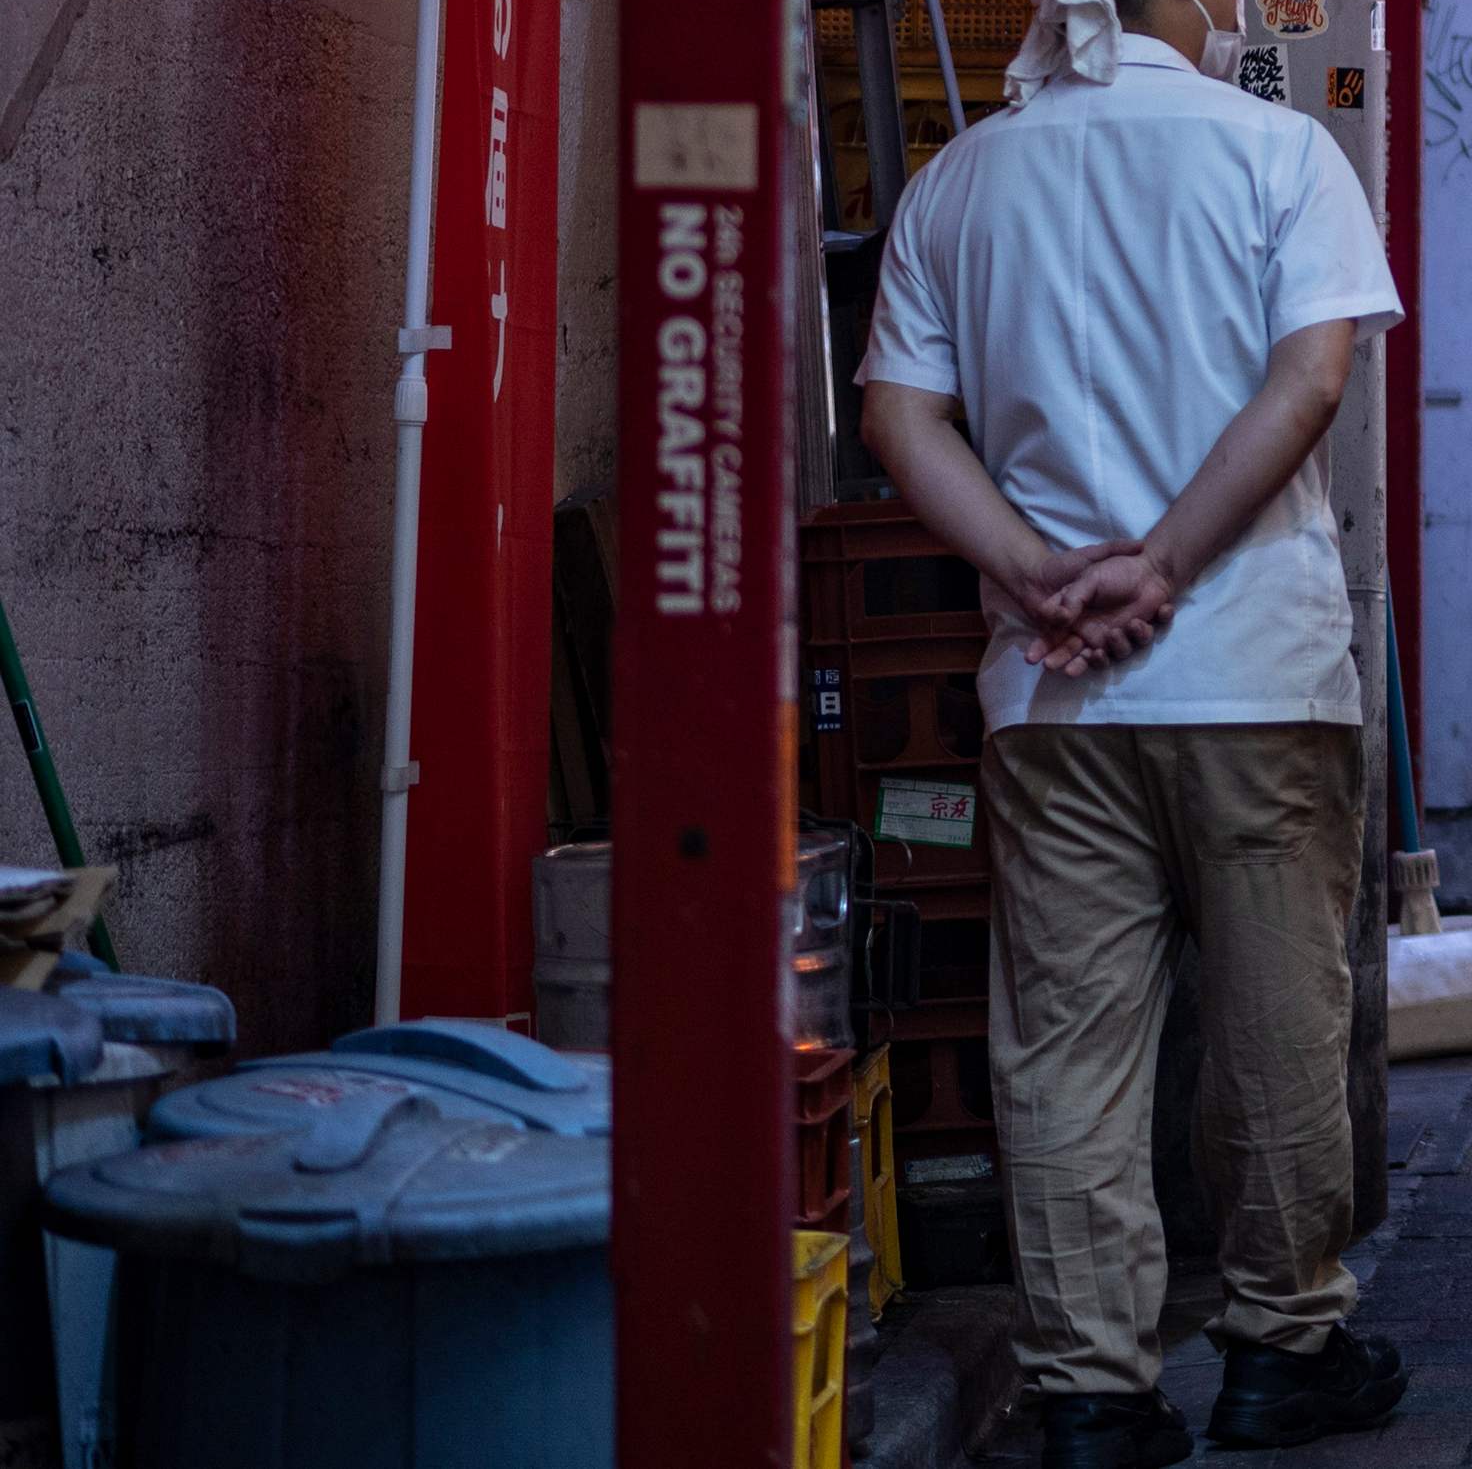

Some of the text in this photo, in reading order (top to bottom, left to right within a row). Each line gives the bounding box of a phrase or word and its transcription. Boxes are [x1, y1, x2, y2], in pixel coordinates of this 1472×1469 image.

[655, 203, 707, 615] NO GRAFFITI
[711, 268, 744, 441] SECURITY
[710, 443, 743, 614] CAMERAS
